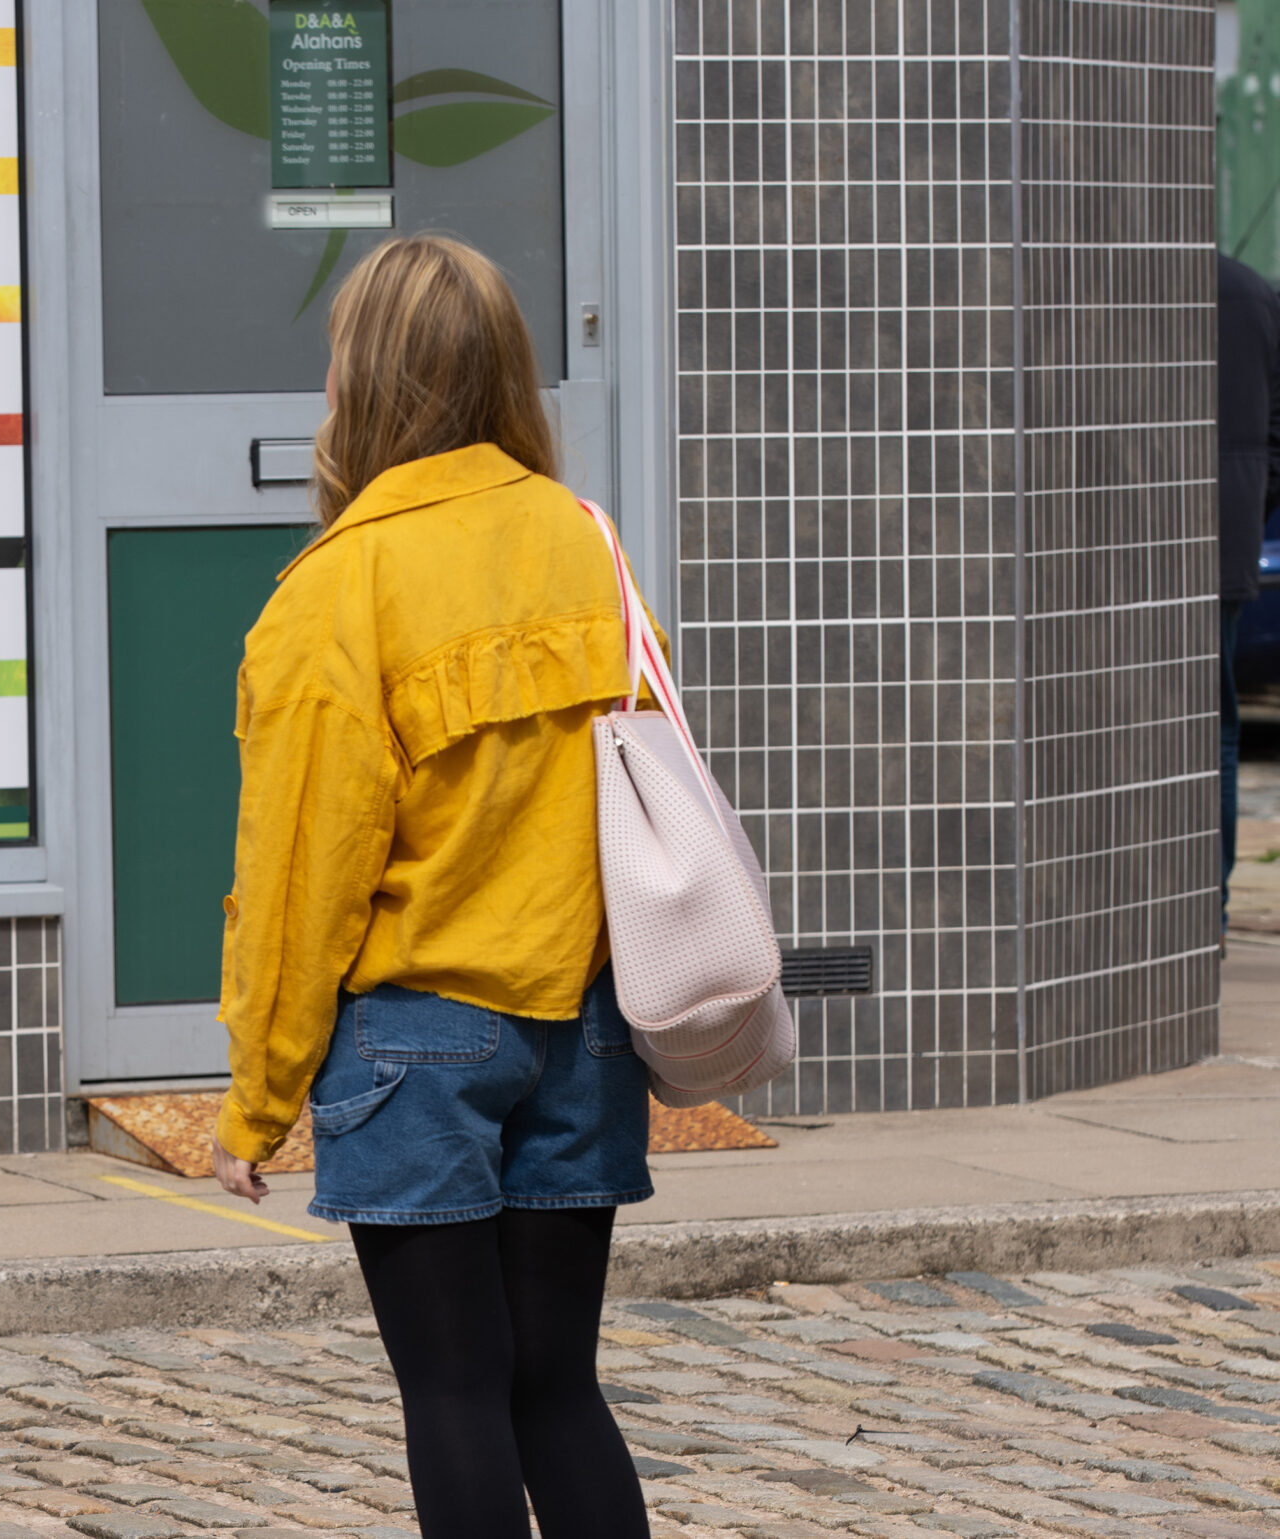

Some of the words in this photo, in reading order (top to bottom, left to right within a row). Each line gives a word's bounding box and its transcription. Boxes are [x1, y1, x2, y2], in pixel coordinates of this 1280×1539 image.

[295, 12, 357, 29] D&A&A
[291, 33, 362, 49] Alahans
[282, 58, 332, 72] Opening
[334, 58, 371, 70] Times
[288, 206, 317, 216] OPEN
